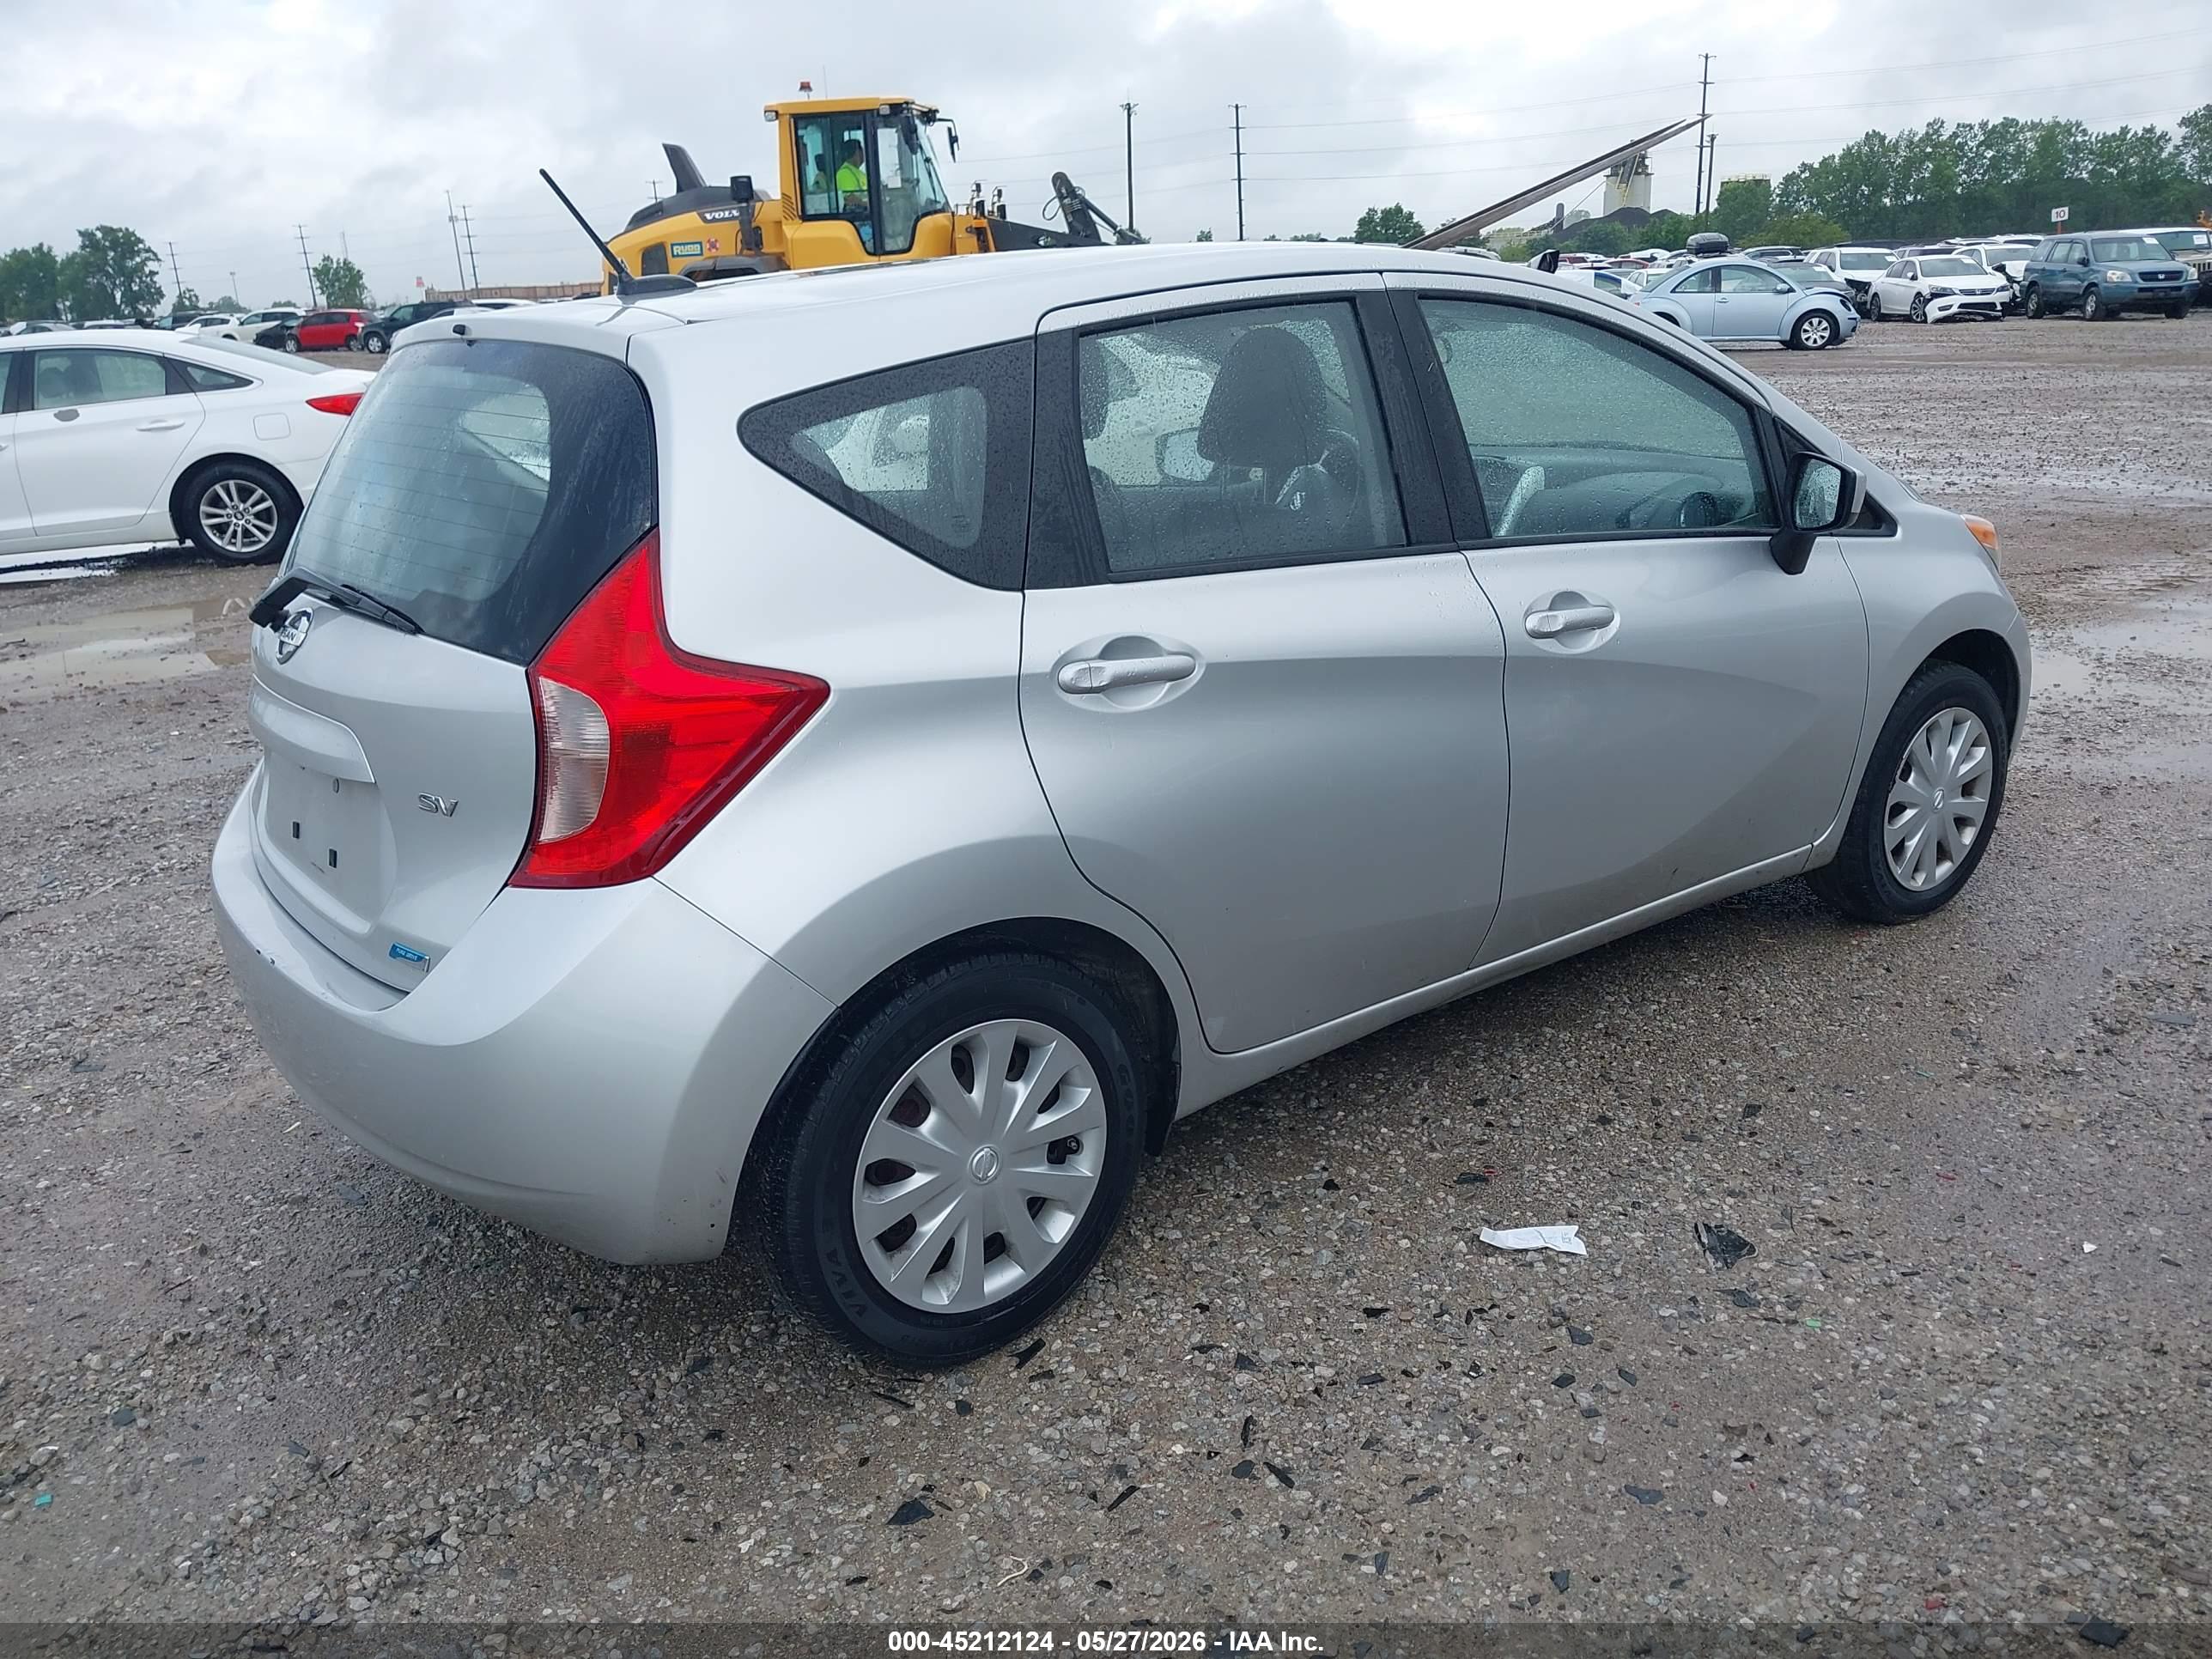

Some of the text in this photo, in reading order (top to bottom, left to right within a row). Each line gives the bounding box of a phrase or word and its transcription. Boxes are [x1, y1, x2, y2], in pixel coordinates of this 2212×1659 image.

[704, 210, 739, 220] VOLV
[2056, 210, 2066, 219] 10
[419, 793, 459, 817] SV
